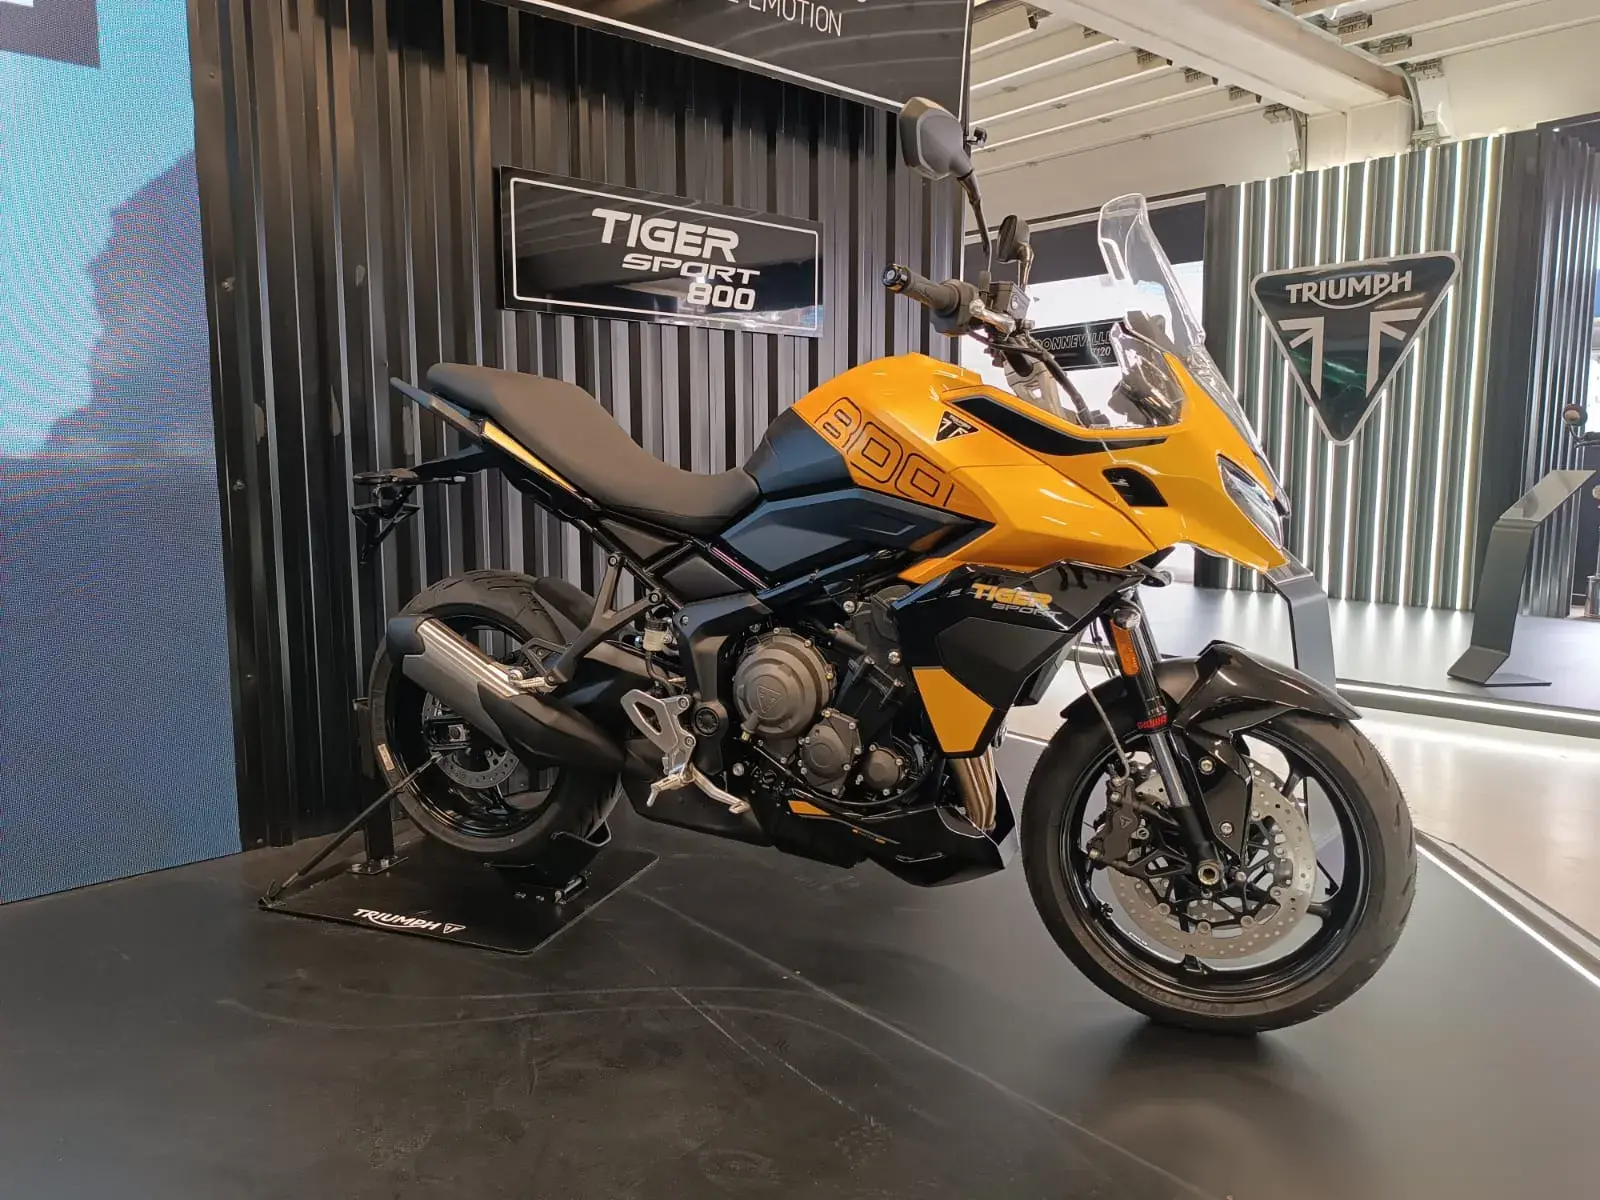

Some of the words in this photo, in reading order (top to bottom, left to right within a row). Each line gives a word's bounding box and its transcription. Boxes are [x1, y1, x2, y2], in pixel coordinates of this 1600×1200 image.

[592, 207, 739, 263] TIGER
[622, 253, 760, 284] SPORT
[687, 282, 756, 310] 800
[1285, 270, 1412, 309] TRIUMPH
[971, 582, 1053, 611] TIGER
[991, 602, 1063, 618] SPORT
[353, 908, 441, 930] TRIUMPH
